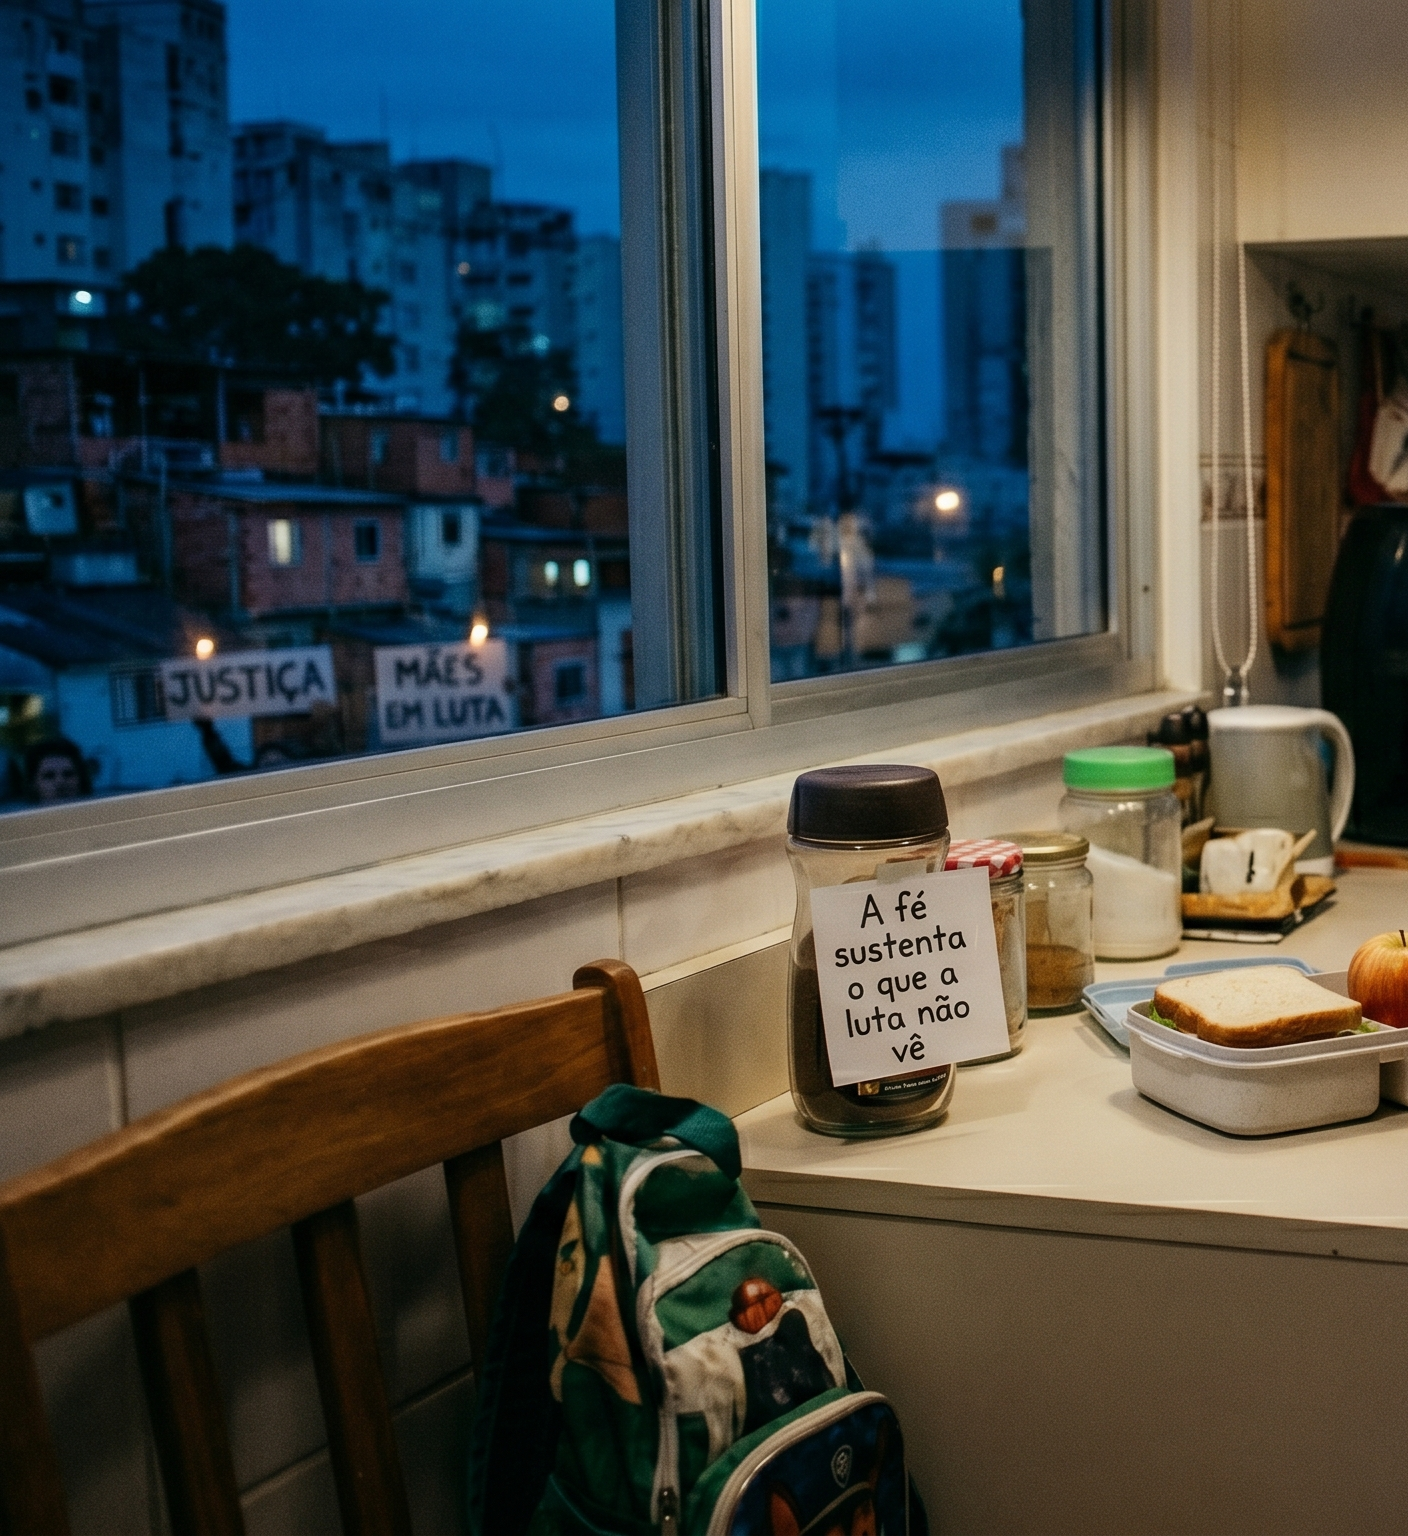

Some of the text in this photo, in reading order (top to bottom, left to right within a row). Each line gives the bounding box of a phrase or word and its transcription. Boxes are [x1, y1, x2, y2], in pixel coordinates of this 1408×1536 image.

[167, 659, 325, 705] JUSTIÇA
[395, 649, 484, 688] MÃES
[385, 695, 505, 730] EM LUTA
[860, 890, 927, 929] A fé
[834, 924, 967, 968] sustenta
[848, 967, 959, 1003] o que a
[845, 994, 970, 1038] luta não
[891, 1032, 925, 1063] vê
